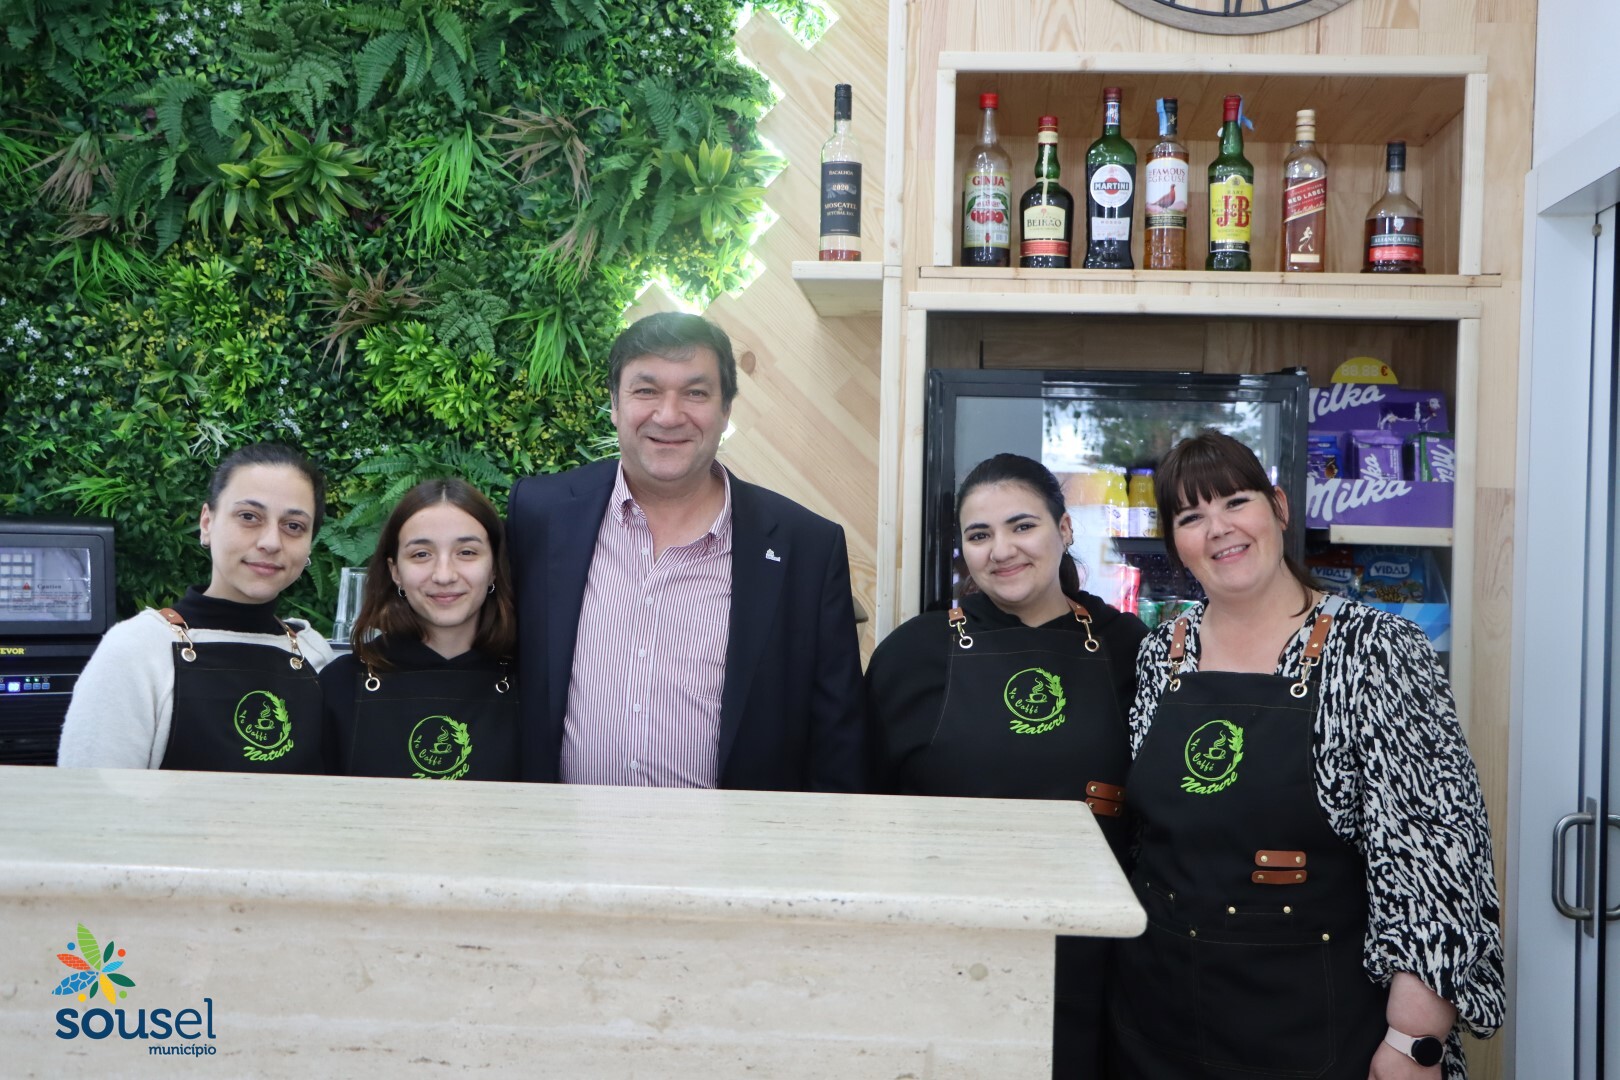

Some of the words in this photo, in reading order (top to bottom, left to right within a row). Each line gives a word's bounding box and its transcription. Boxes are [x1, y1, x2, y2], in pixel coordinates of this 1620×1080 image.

[1094, 182, 1130, 190] MARTINI
[1287, 195, 1302, 204] RED
[1303, 188, 1325, 199] LABEL
[1305, 477, 1412, 522] Milka
[1374, 564, 1408, 575] VIDAL
[1009, 713, 1066, 734] Nature
[243, 739, 294, 761] Nature
[1180, 771, 1238, 794] Nature
